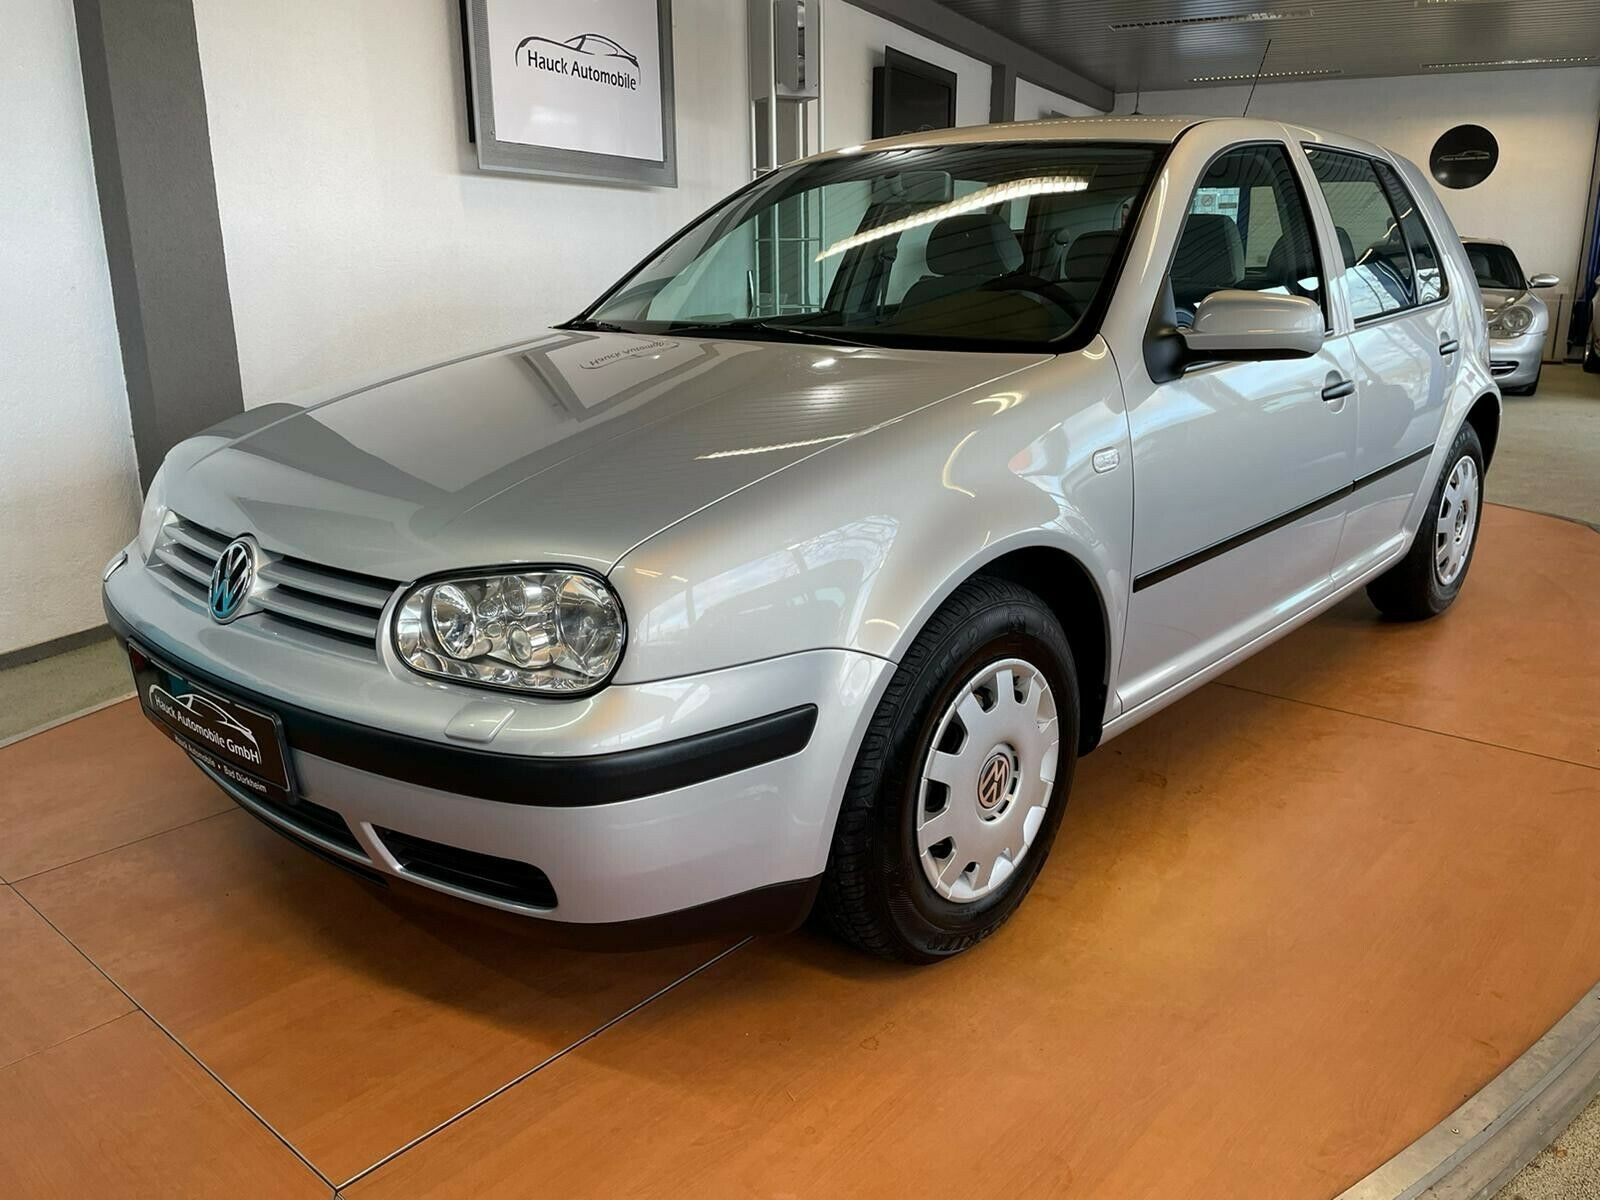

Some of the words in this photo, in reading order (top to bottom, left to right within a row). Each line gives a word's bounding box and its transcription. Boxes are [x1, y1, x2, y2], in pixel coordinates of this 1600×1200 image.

[527, 50, 568, 75] Hauck
[571, 61, 637, 90] Automobile
[155, 695, 176, 719] Hauck
[177, 710, 226, 749] Automobile
[226, 738, 260, 765] GmbH
[223, 765, 236, 780] Bad
